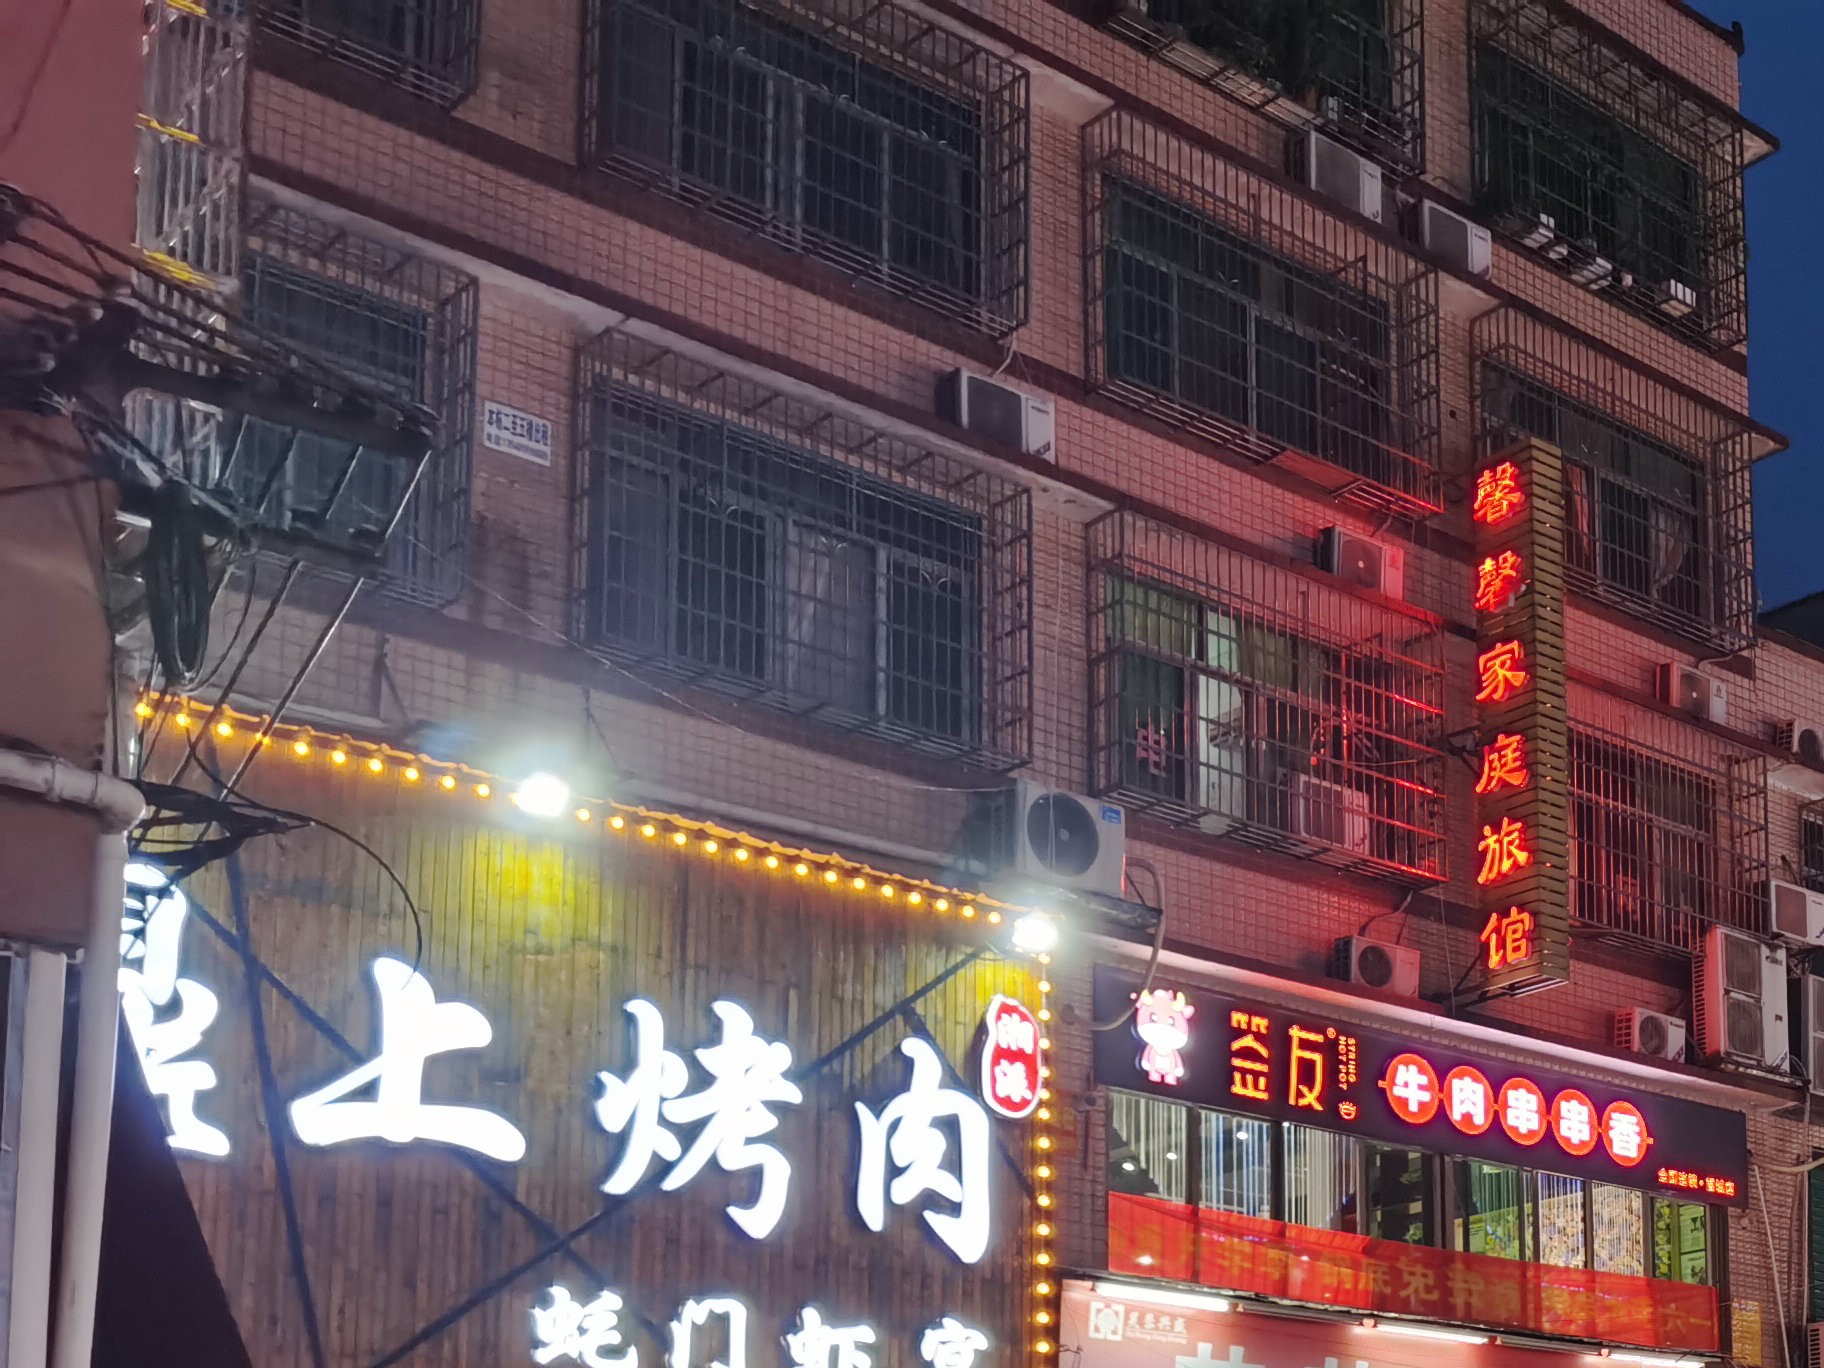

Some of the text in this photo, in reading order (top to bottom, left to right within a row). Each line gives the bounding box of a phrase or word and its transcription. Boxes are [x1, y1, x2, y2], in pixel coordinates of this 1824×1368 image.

[1391, 1066, 1643, 1166] 牛肉串串香
